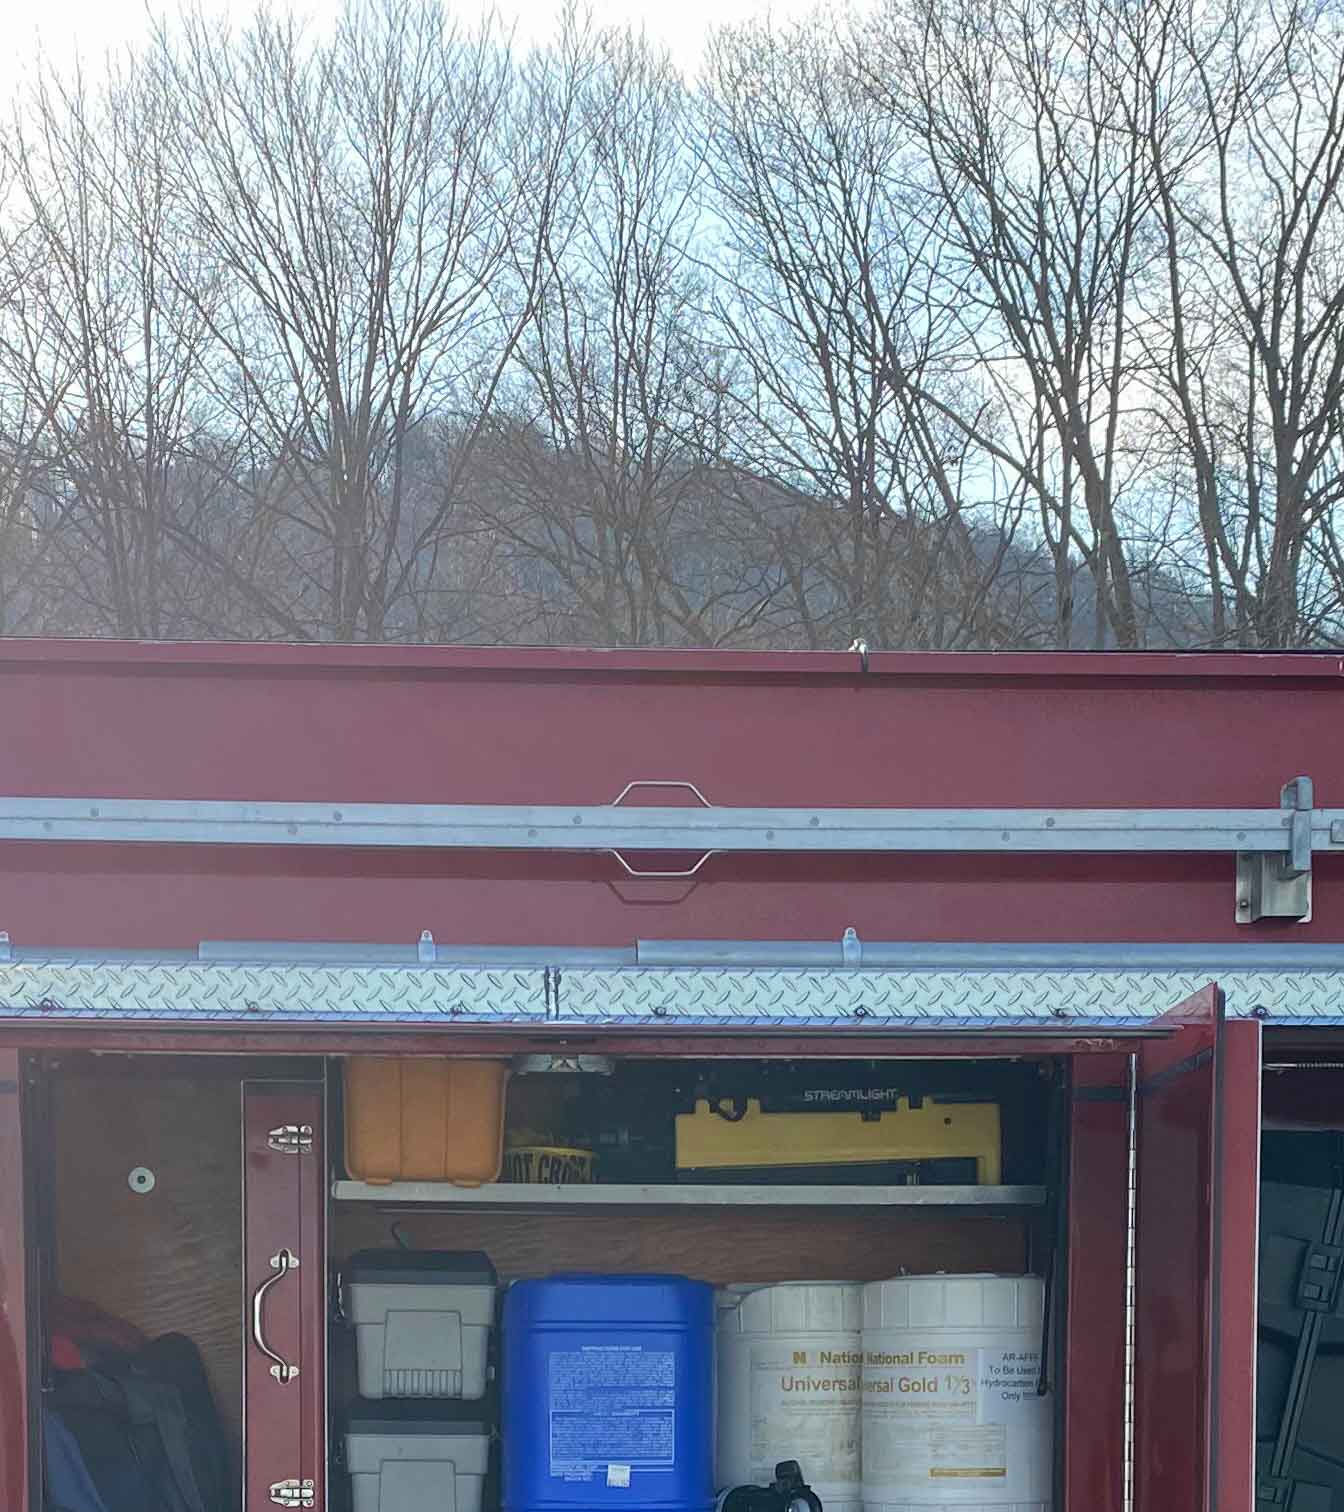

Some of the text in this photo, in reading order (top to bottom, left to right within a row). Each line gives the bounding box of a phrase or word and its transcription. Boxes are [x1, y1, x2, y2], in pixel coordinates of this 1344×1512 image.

[803, 1088, 897, 1102] STREAMLIGHT
[918, 1351, 965, 1365] Foam
[781, 1375, 862, 1392] Universal
[898, 1376, 939, 1393] Gold
[1001, 1391, 1020, 1402] Only
